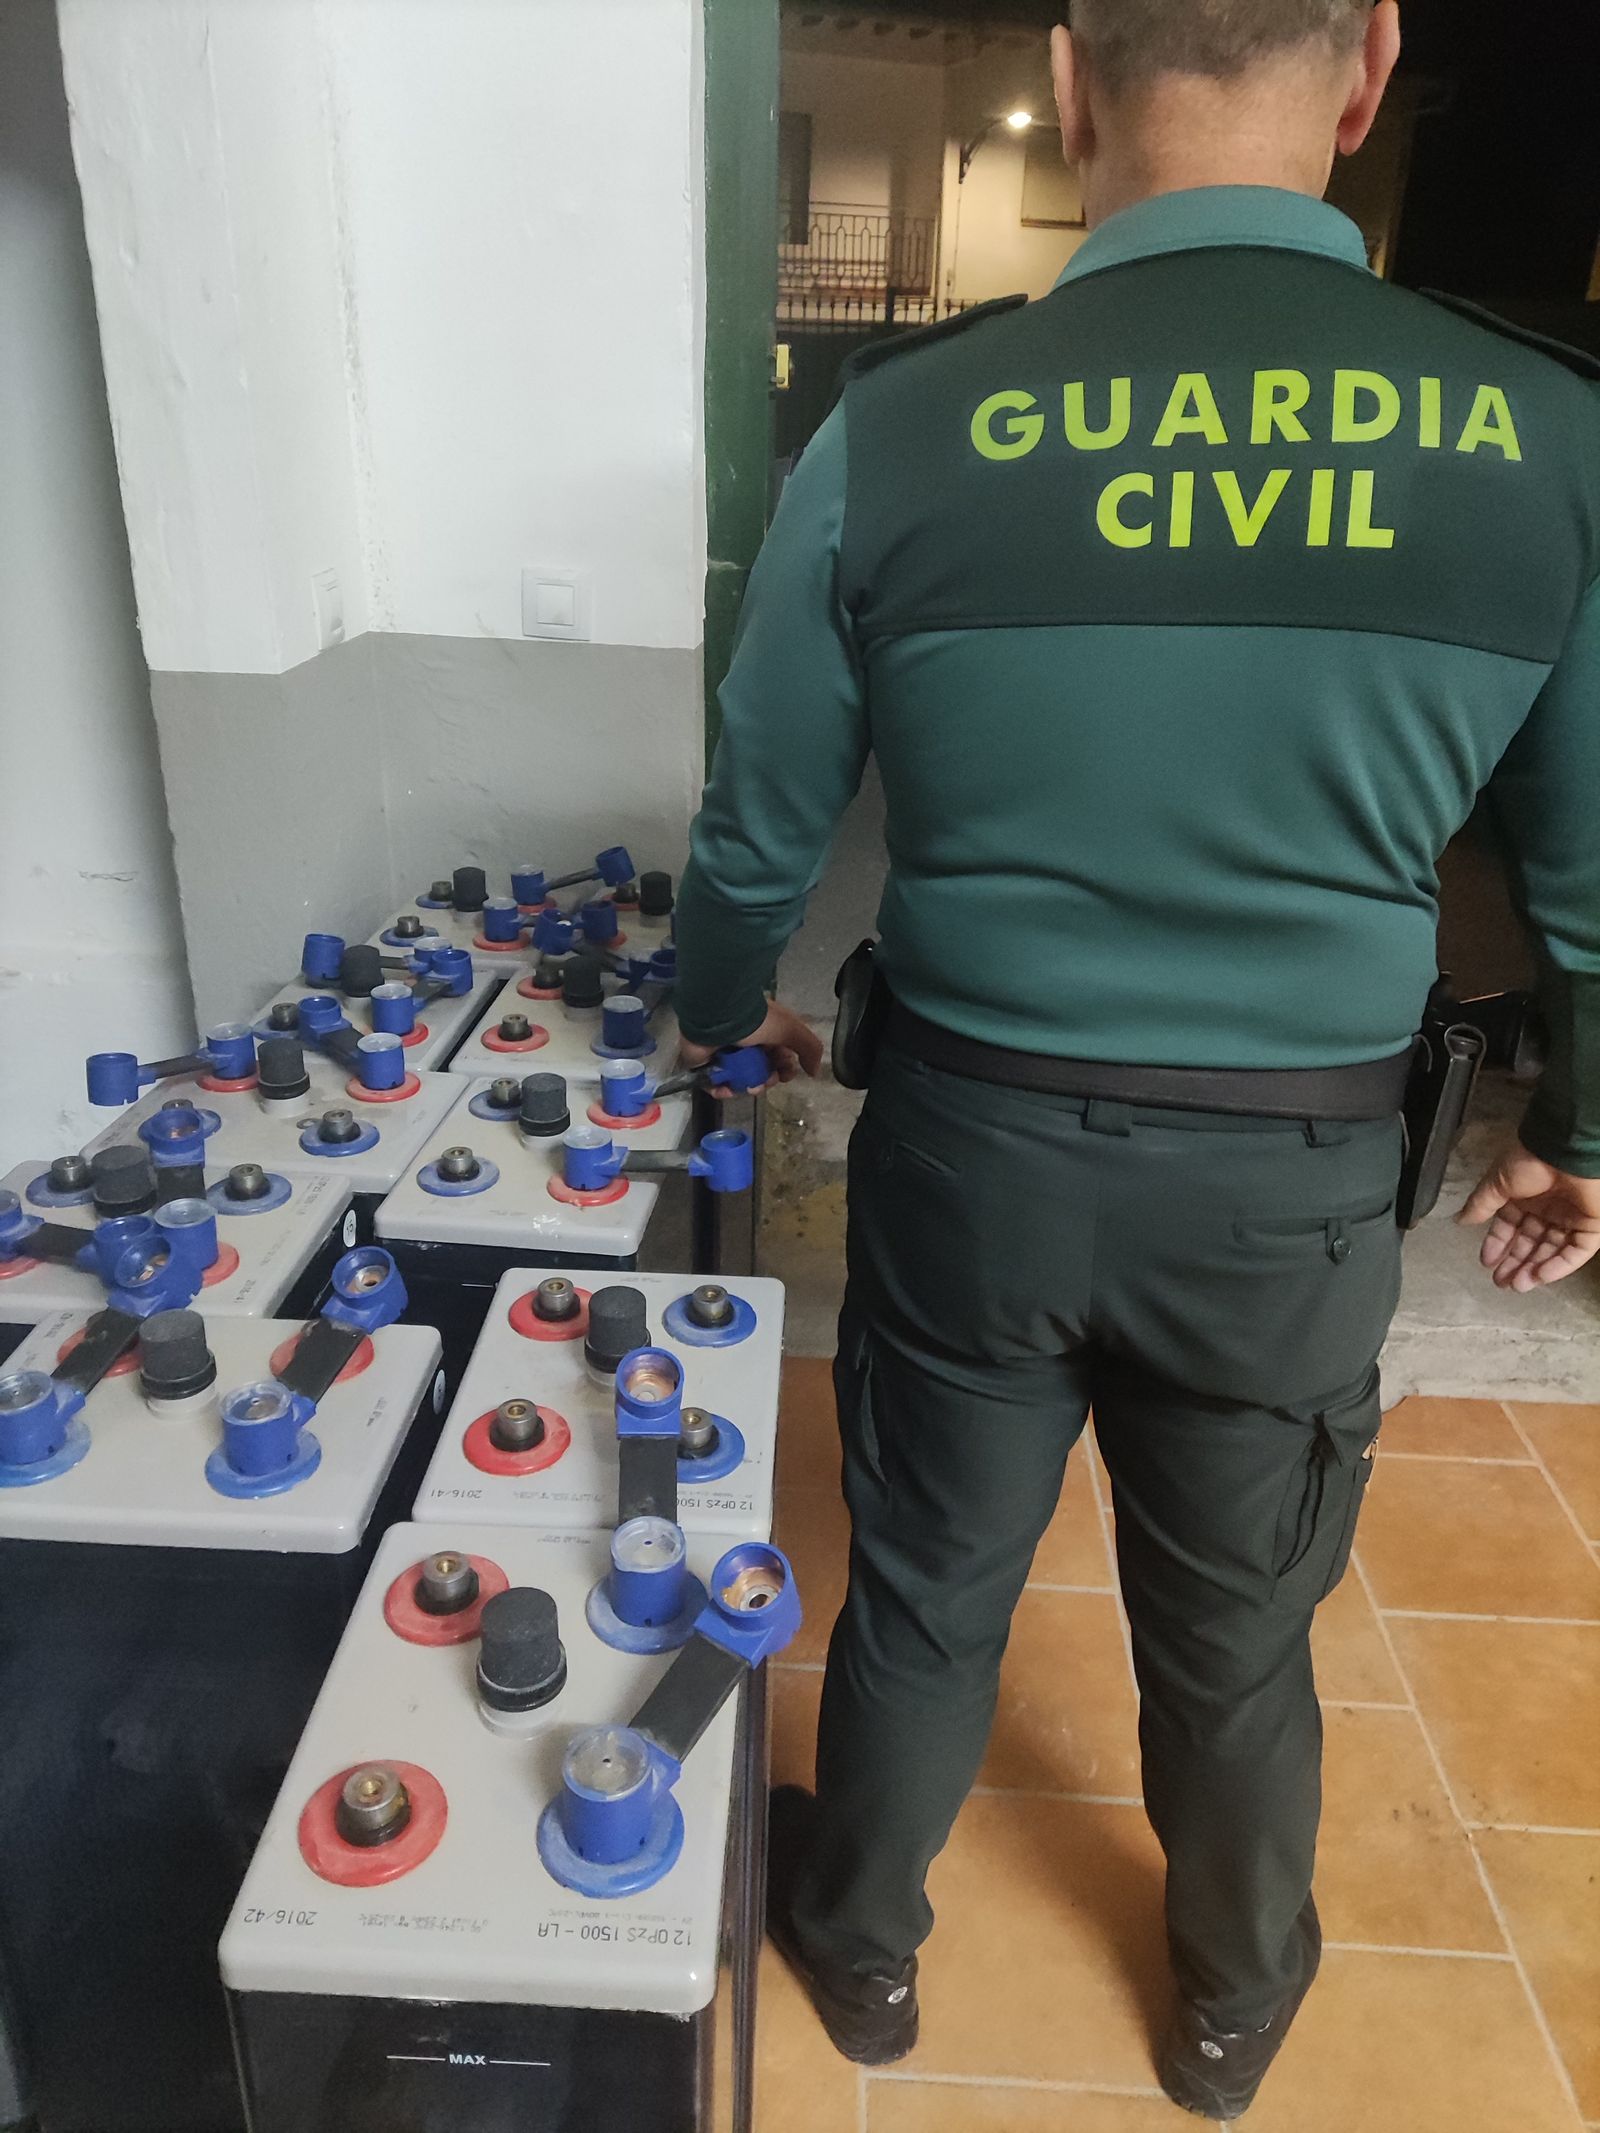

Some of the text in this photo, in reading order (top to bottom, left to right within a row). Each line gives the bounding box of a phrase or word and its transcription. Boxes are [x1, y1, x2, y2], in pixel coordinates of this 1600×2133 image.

[970, 368, 1523, 462] GUARDIA
[1095, 468, 1396, 550] CIVIL
[430, 1489, 483, 1499] 2016/41
[739, 1500, 753, 1511] 12
[243, 1908, 318, 1926] 2016/42
[538, 1922, 559, 1939] LA
[580, 1924, 619, 1942] 1500
[673, 1929, 692, 1946] 12
[449, 2053, 487, 2066] MAX
